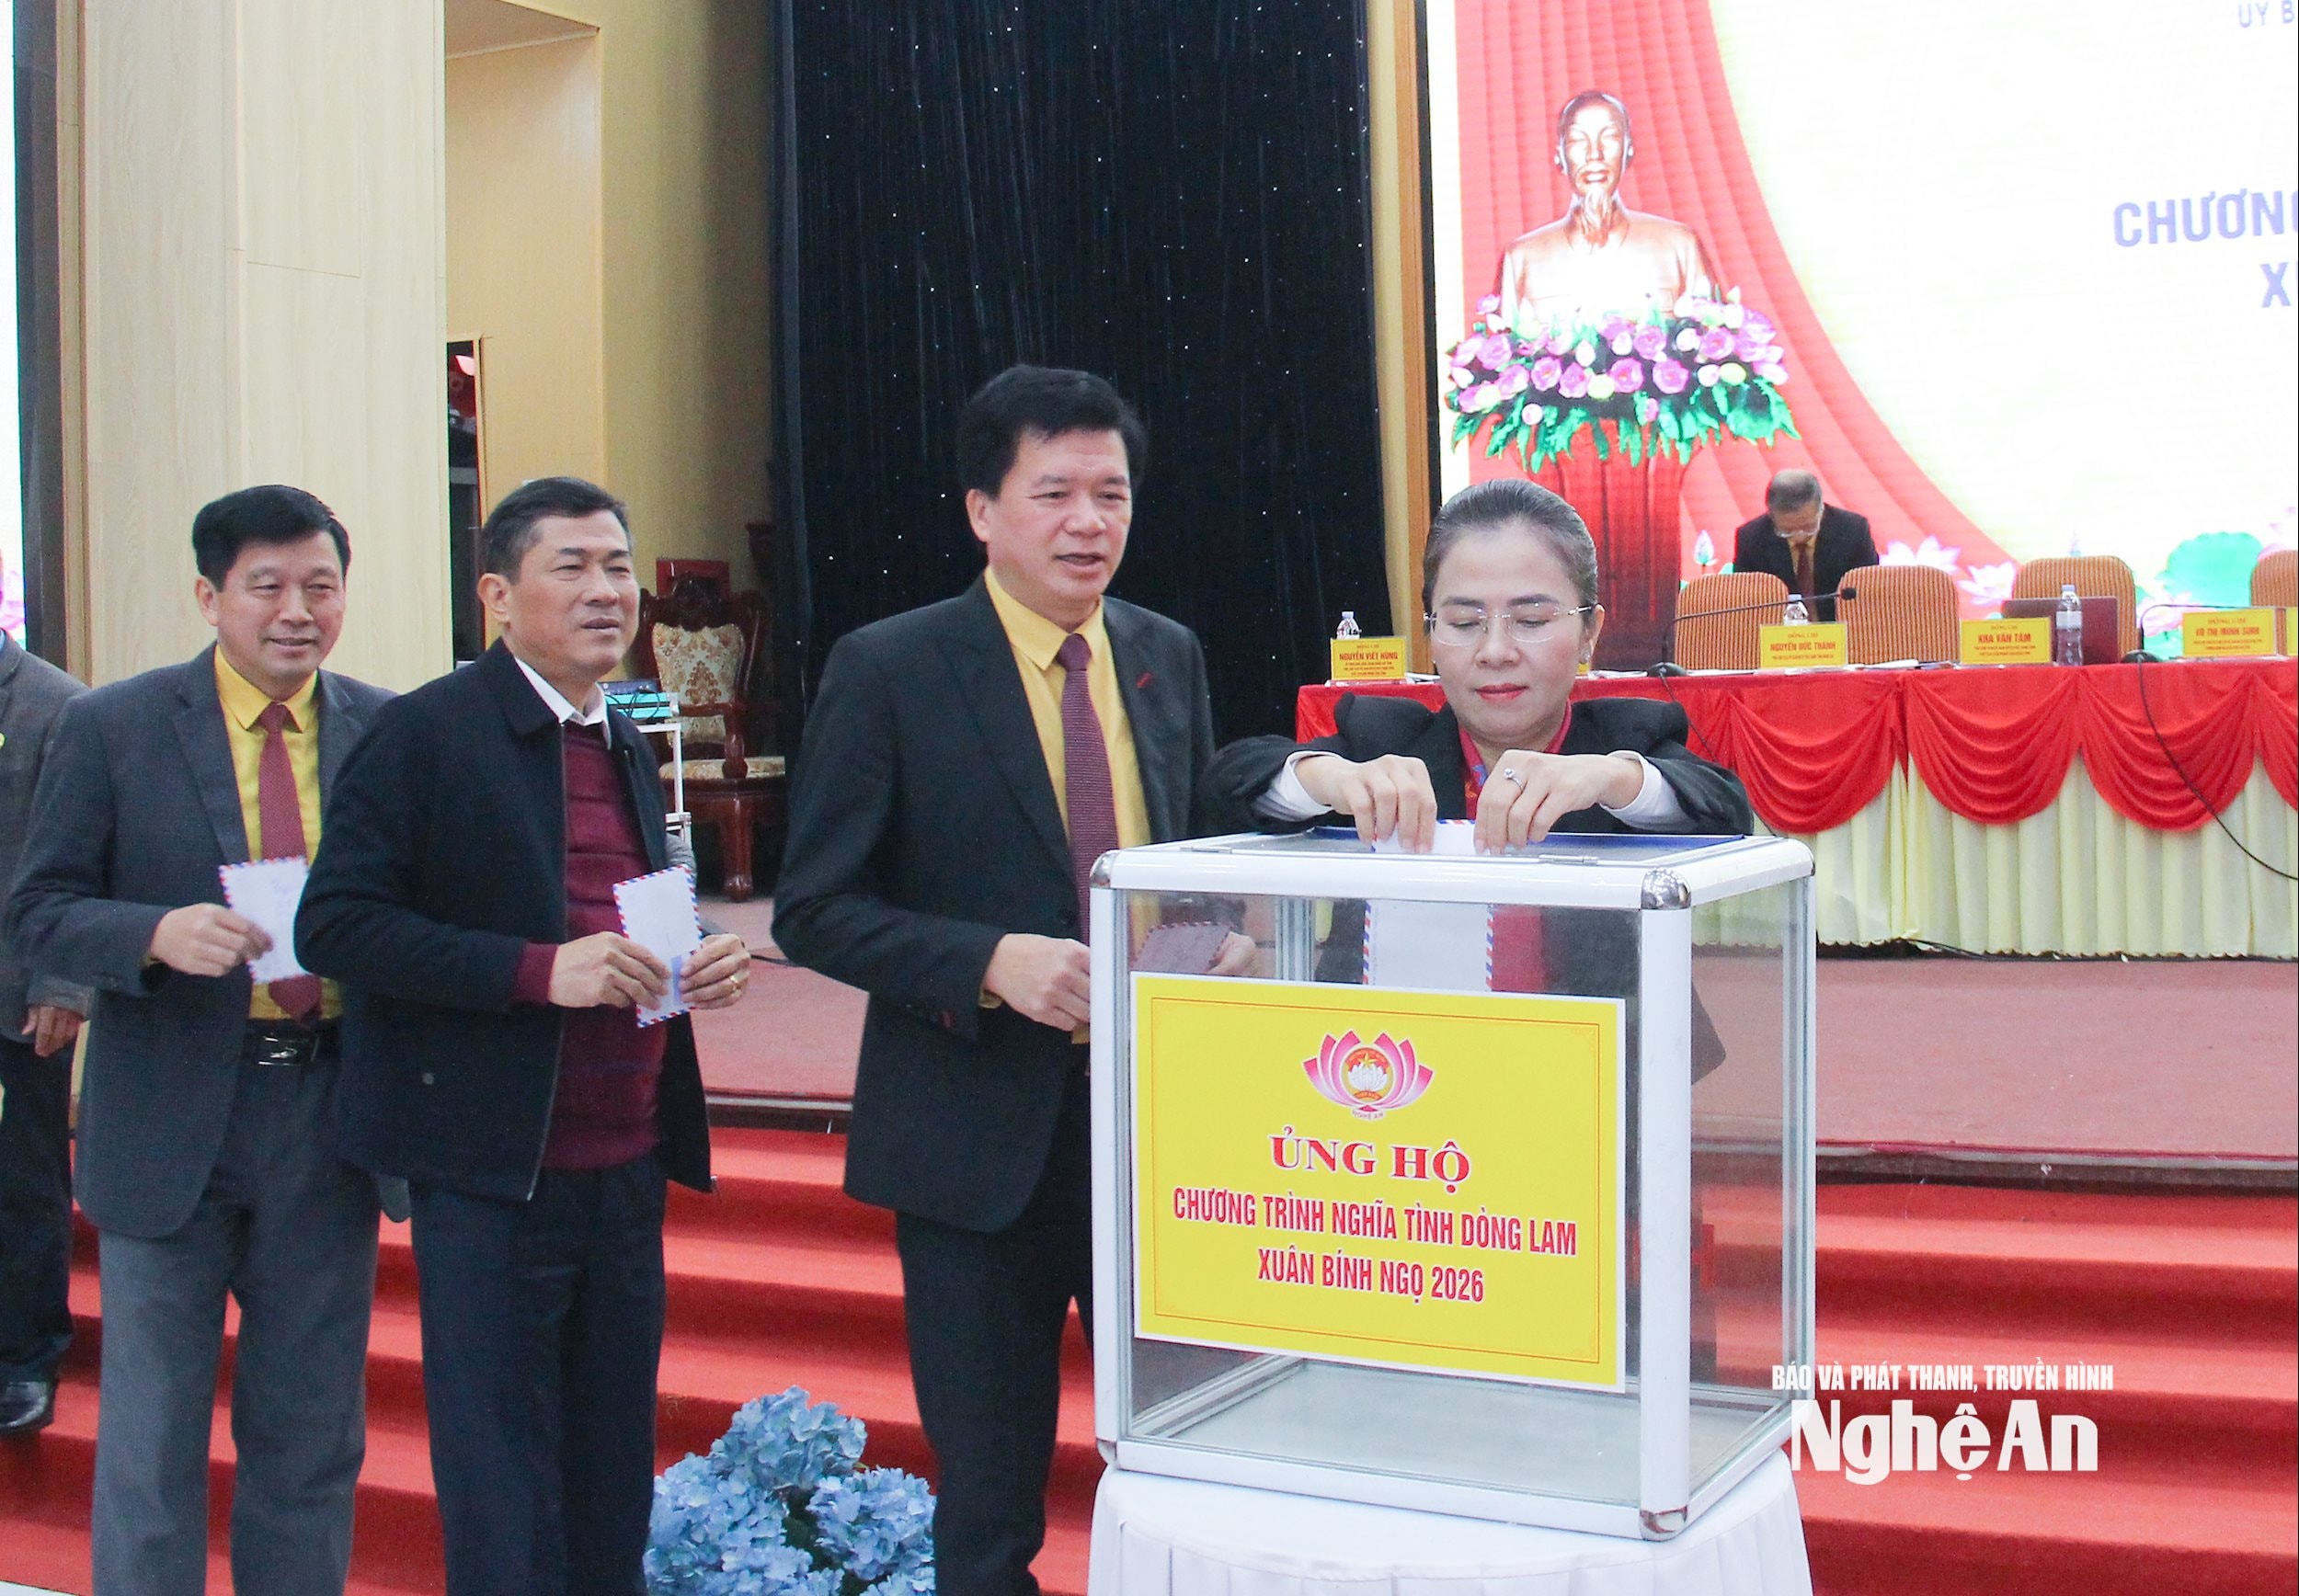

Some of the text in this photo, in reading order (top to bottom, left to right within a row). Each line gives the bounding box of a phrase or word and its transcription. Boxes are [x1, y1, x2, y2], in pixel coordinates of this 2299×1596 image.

[2113, 188, 2298, 247] CHƯƠN
[2259, 262, 2298, 308] X
[1269, 1125, 1470, 1193] ỦNG HỘ
[1173, 1187, 1576, 1256] CHƯƠNG TRÌNH NGHĨA TÌNH DÒNG LAM
[1258, 1244, 1484, 1304] XUÂN BÍNH NGỌ 2026
